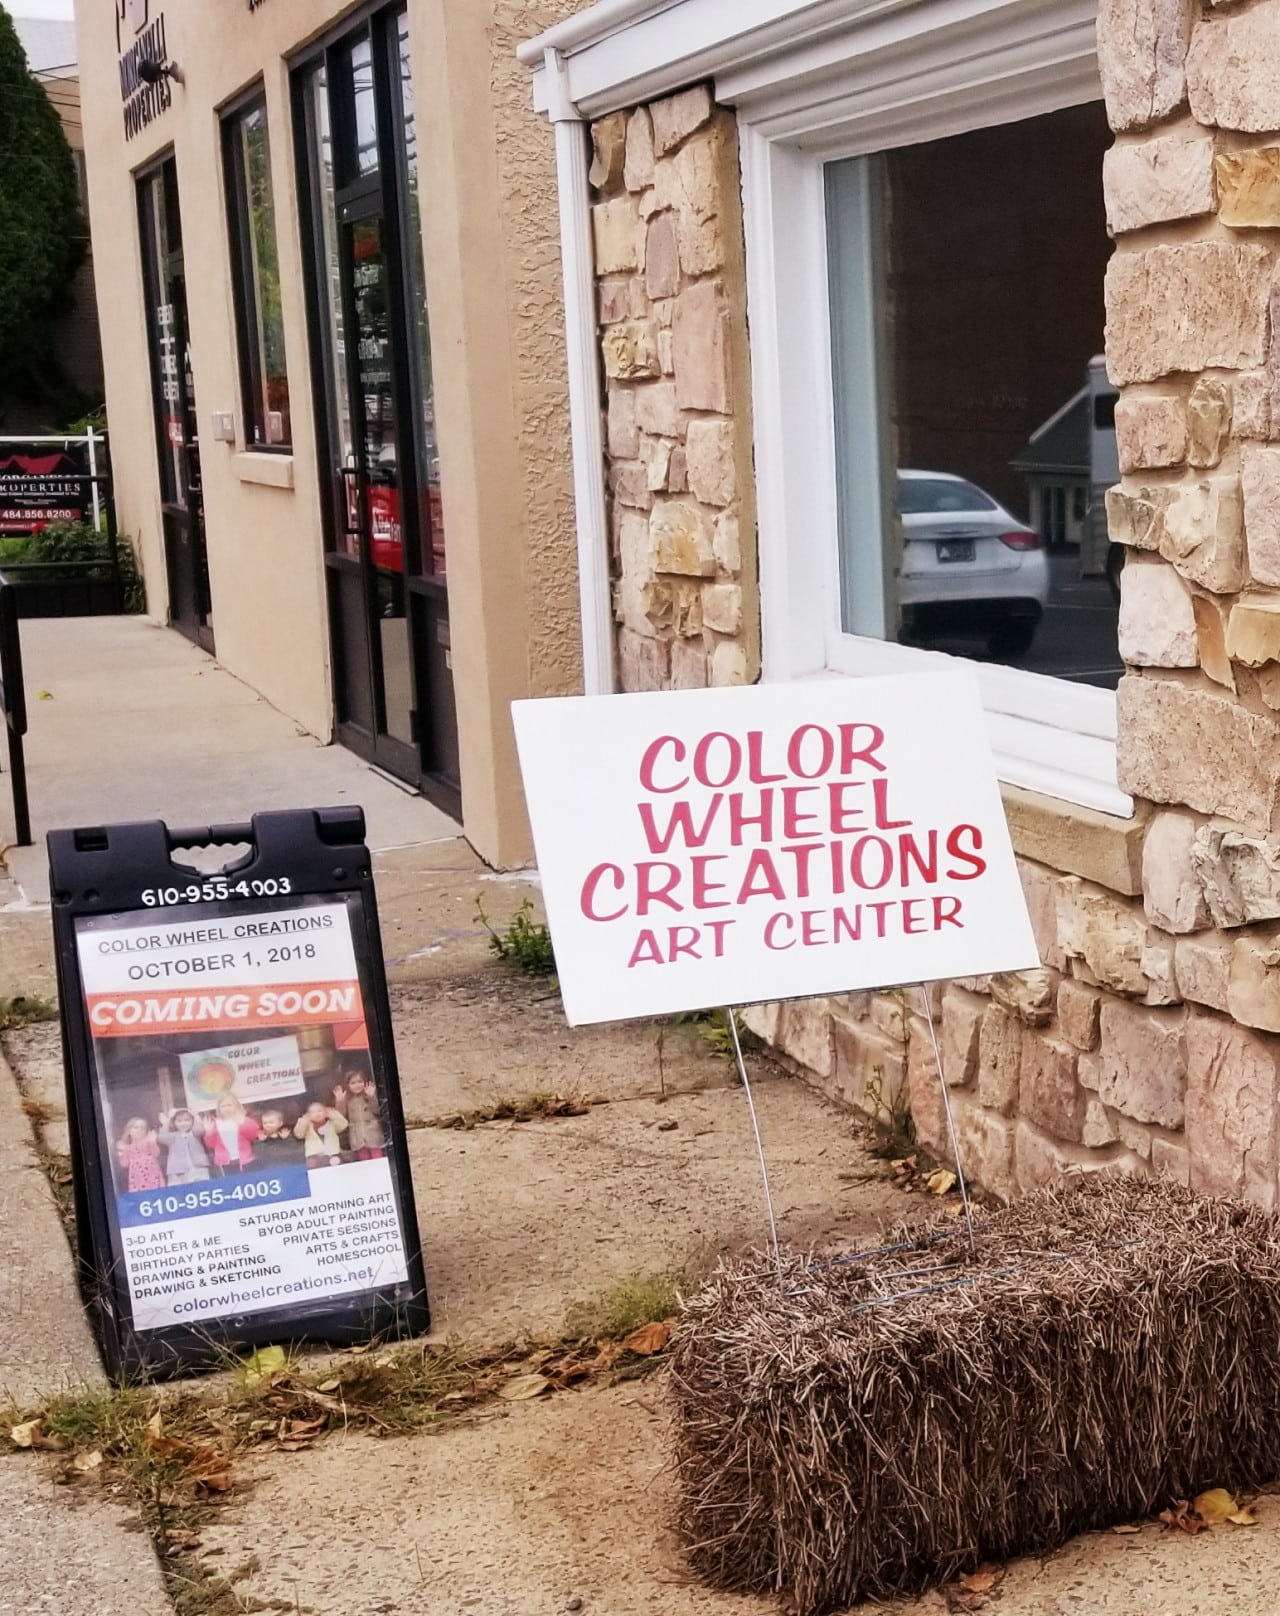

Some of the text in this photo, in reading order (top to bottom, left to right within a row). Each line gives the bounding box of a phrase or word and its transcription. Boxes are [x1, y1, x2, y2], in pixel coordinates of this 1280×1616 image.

[638, 723, 887, 794] COLOR
[637, 778, 913, 854] WHEEL
[580, 823, 987, 922] CREATIONS
[142, 877, 291, 906] 610-955-4003
[98, 915, 333, 954] COLOR WHEEL CREATIONS
[627, 895, 965, 968] ART CENTER
[128, 943, 315, 980] OCTOBER 1, 2018
[91, 987, 355, 1026] COMING SOON
[228, 1046, 260, 1058] COLOR
[238, 1059, 271, 1071] WHEEL
[247, 1067, 301, 1084] CREATIONS
[139, 1179, 282, 1217] 610-955-4003
[239, 1192, 392, 1228] SATURDAY MORNING ART
[258, 1205, 394, 1238] BYOB ADULT PAINTING
[283, 1217, 397, 1246] PRIVATE SESSIONS
[126, 1230, 174, 1247] 3-D ART
[129, 1236, 222, 1259] TODDLER & ME
[305, 1230, 399, 1255] ARTS & CRAFTS
[317, 1243, 402, 1267] HOMESCHOOL
[130, 1244, 250, 1272] BIRTHDAY PARTIES
[133, 1254, 266, 1286] DRAWING & PAINTING
[134, 1265, 282, 1299] DRAWING & SKETCHING
[173, 1267, 375, 1314] colorwheelcreations.net
